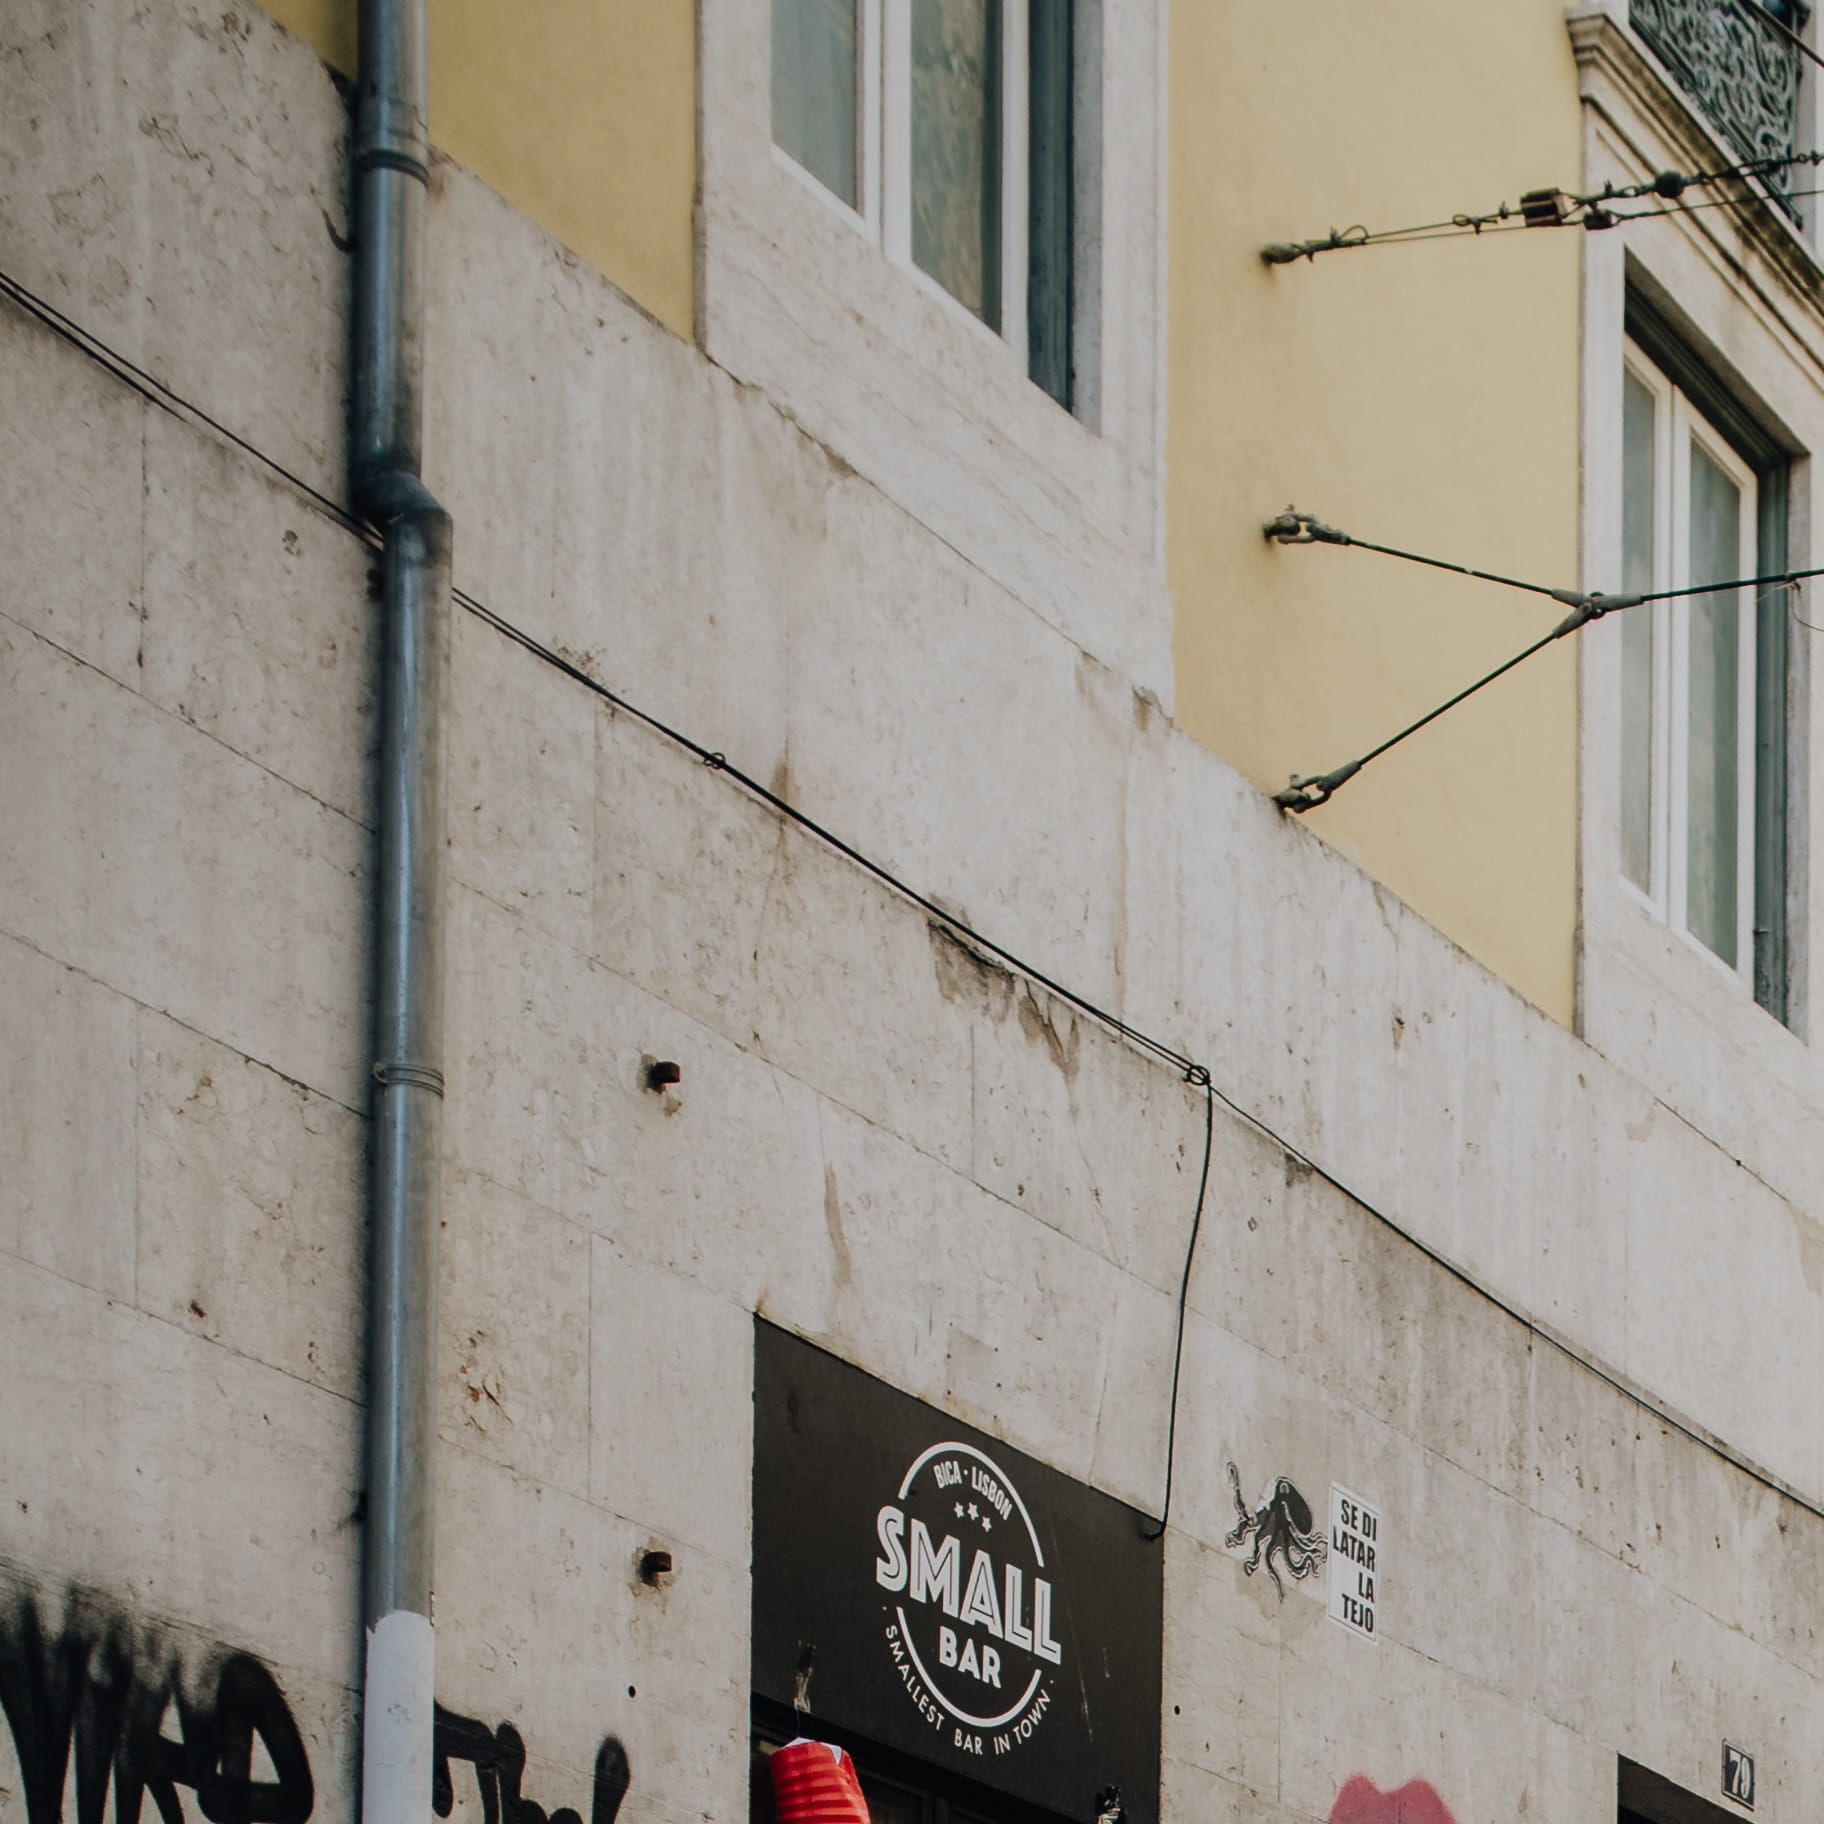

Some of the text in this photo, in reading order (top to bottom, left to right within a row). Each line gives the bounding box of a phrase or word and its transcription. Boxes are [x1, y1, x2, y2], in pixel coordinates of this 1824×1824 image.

[933, 1460, 1013, 1521] BICA LISBON
[1341, 1499, 1377, 1542] SE DI
[1333, 1525, 1376, 1572] LATAR
[876, 1505, 1062, 1666] SMALL
[1358, 1571, 1375, 1604] LA
[1341, 1592, 1375, 1634] TEJO
[939, 1626, 1002, 1689] BAR
[885, 1624, 1052, 1757] SMALLEST BAR IN TOWN
